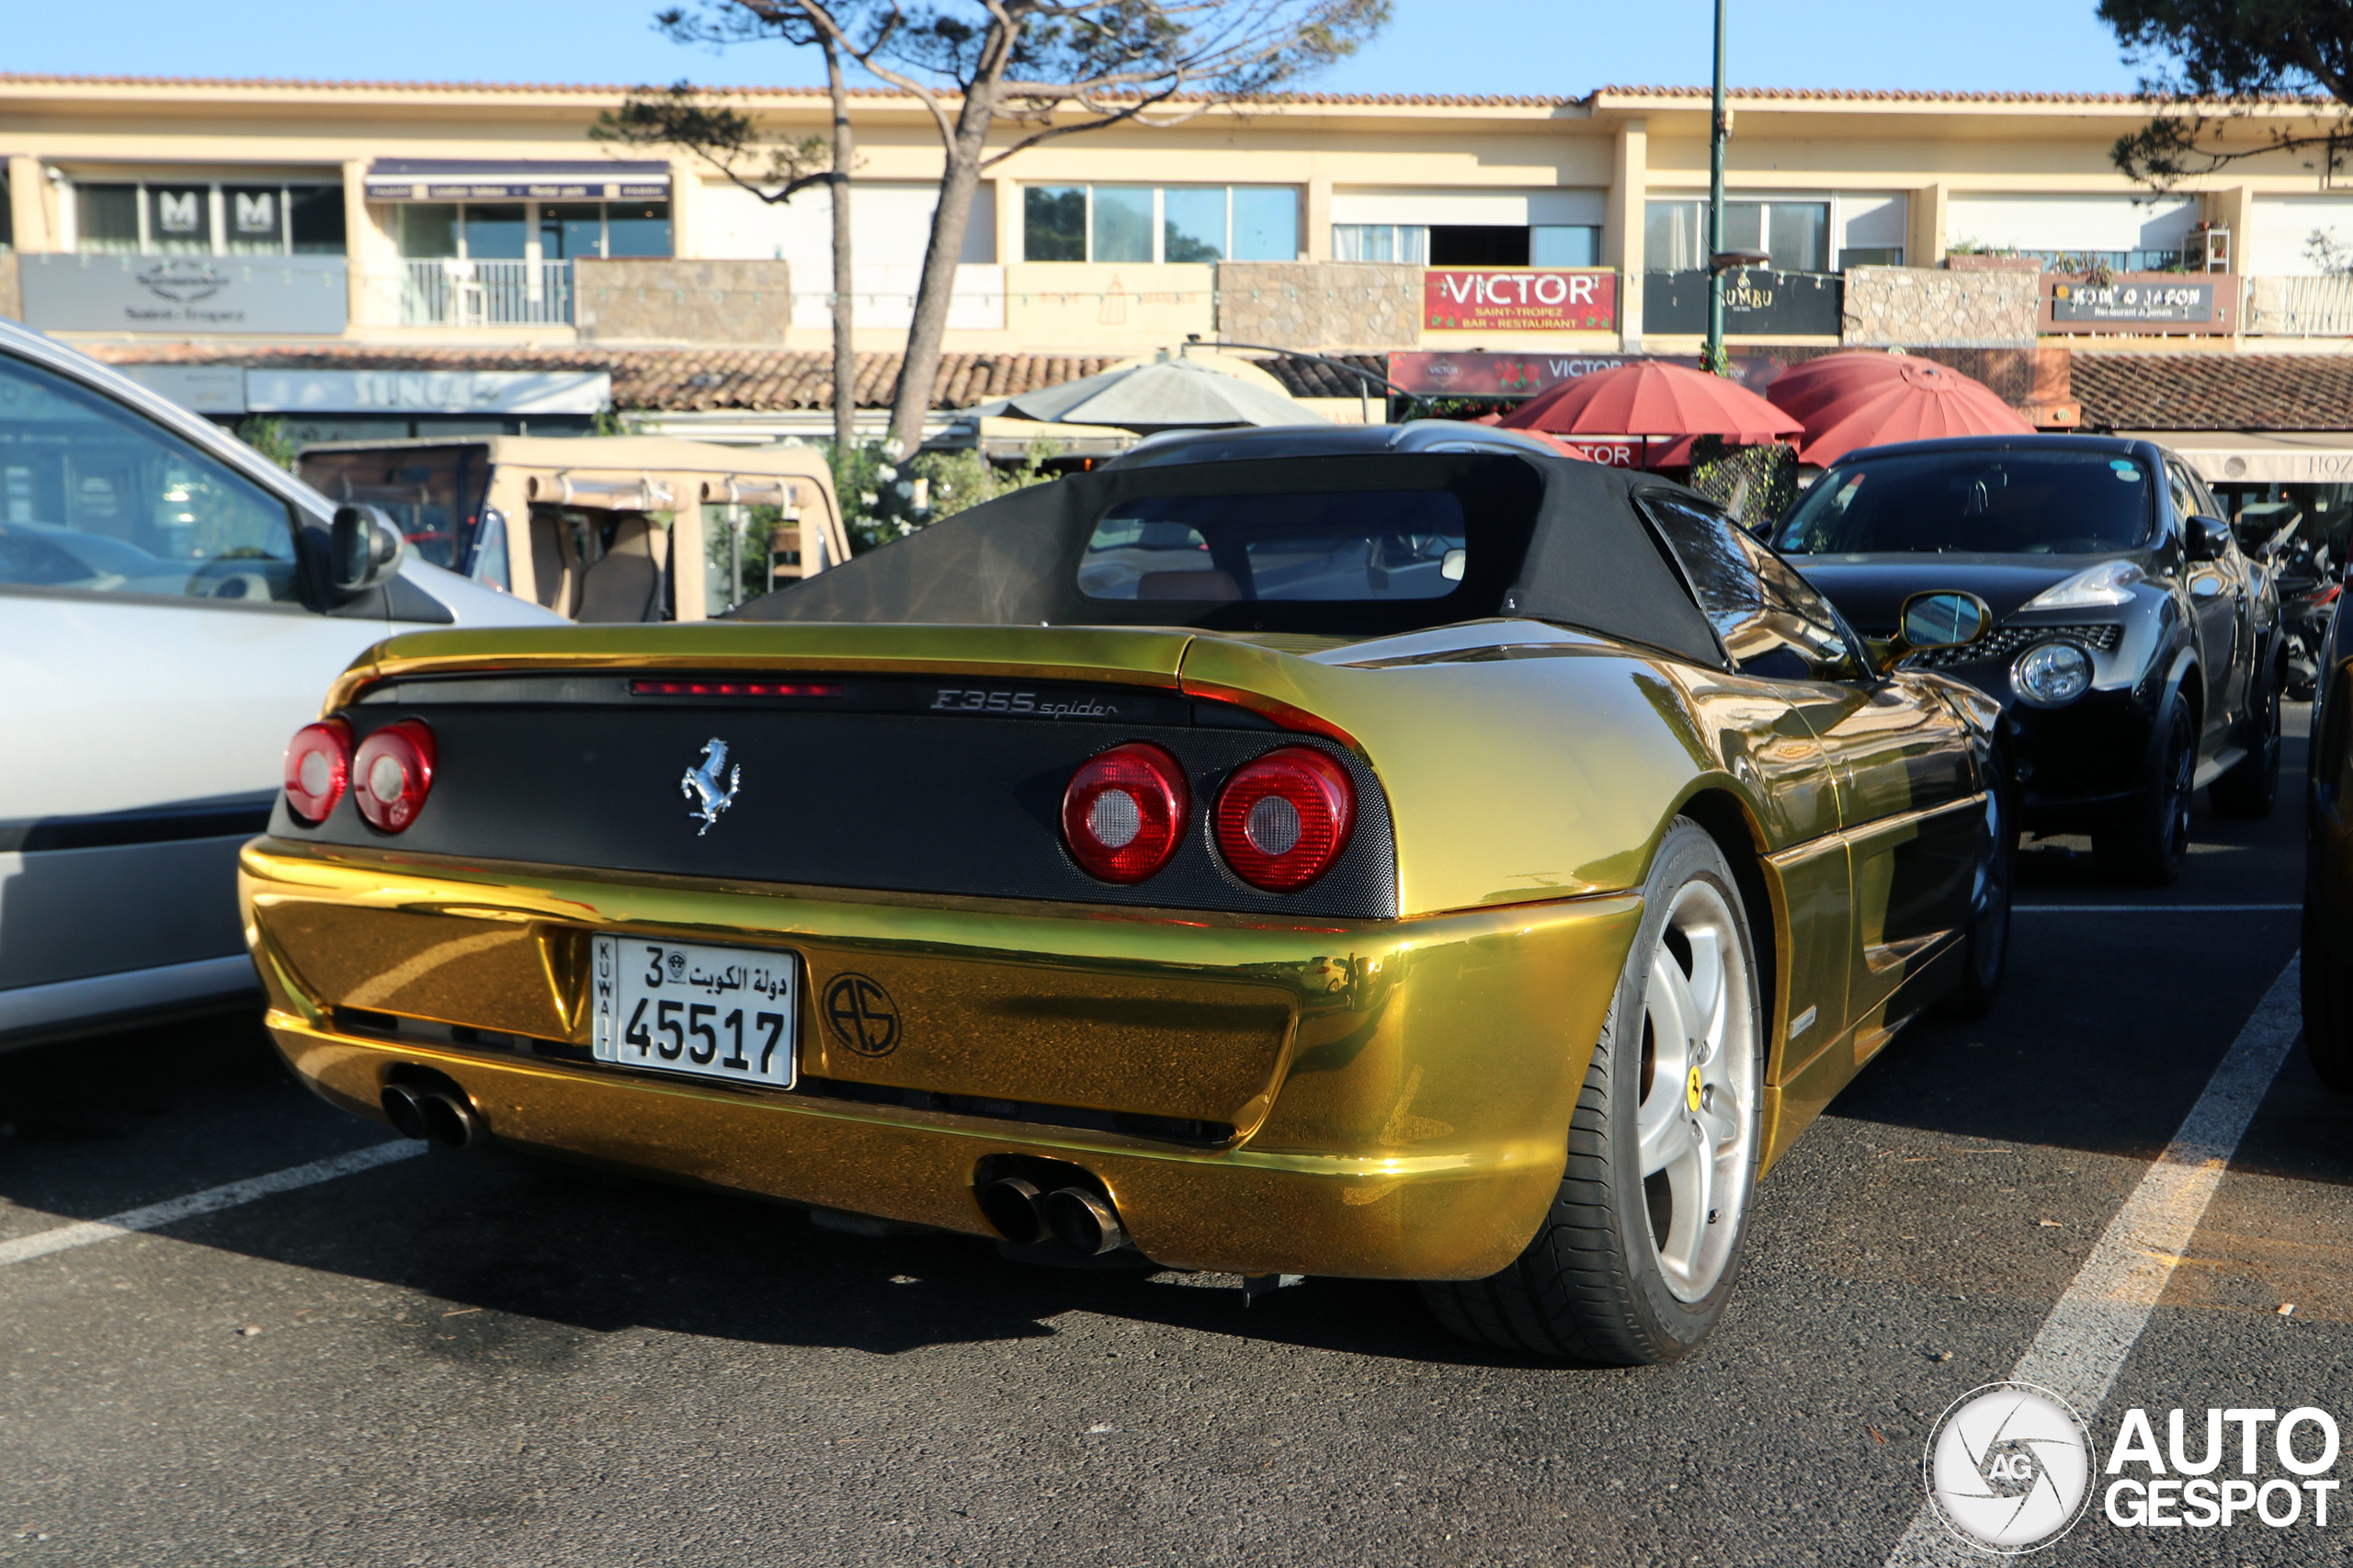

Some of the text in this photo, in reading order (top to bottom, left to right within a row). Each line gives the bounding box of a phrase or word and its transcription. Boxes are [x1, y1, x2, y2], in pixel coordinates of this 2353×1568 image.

[1445, 273, 1595, 304] VICTOR
[1722, 287, 1773, 310] UMBU
[1461, 318, 1488, 329] BAR
[1497, 318, 1577, 329] RESTAURANT
[1474, 306, 1563, 318] SAINT-TROPEZ
[1578, 445, 1631, 465] TOR
[930, 689, 1120, 720] F355 spider
[645, 946, 664, 988] 3
[598, 942, 611, 1056] KUWAIT
[688, 966, 788, 1001] دولة الكويت
[625, 997, 784, 1074] 45517
